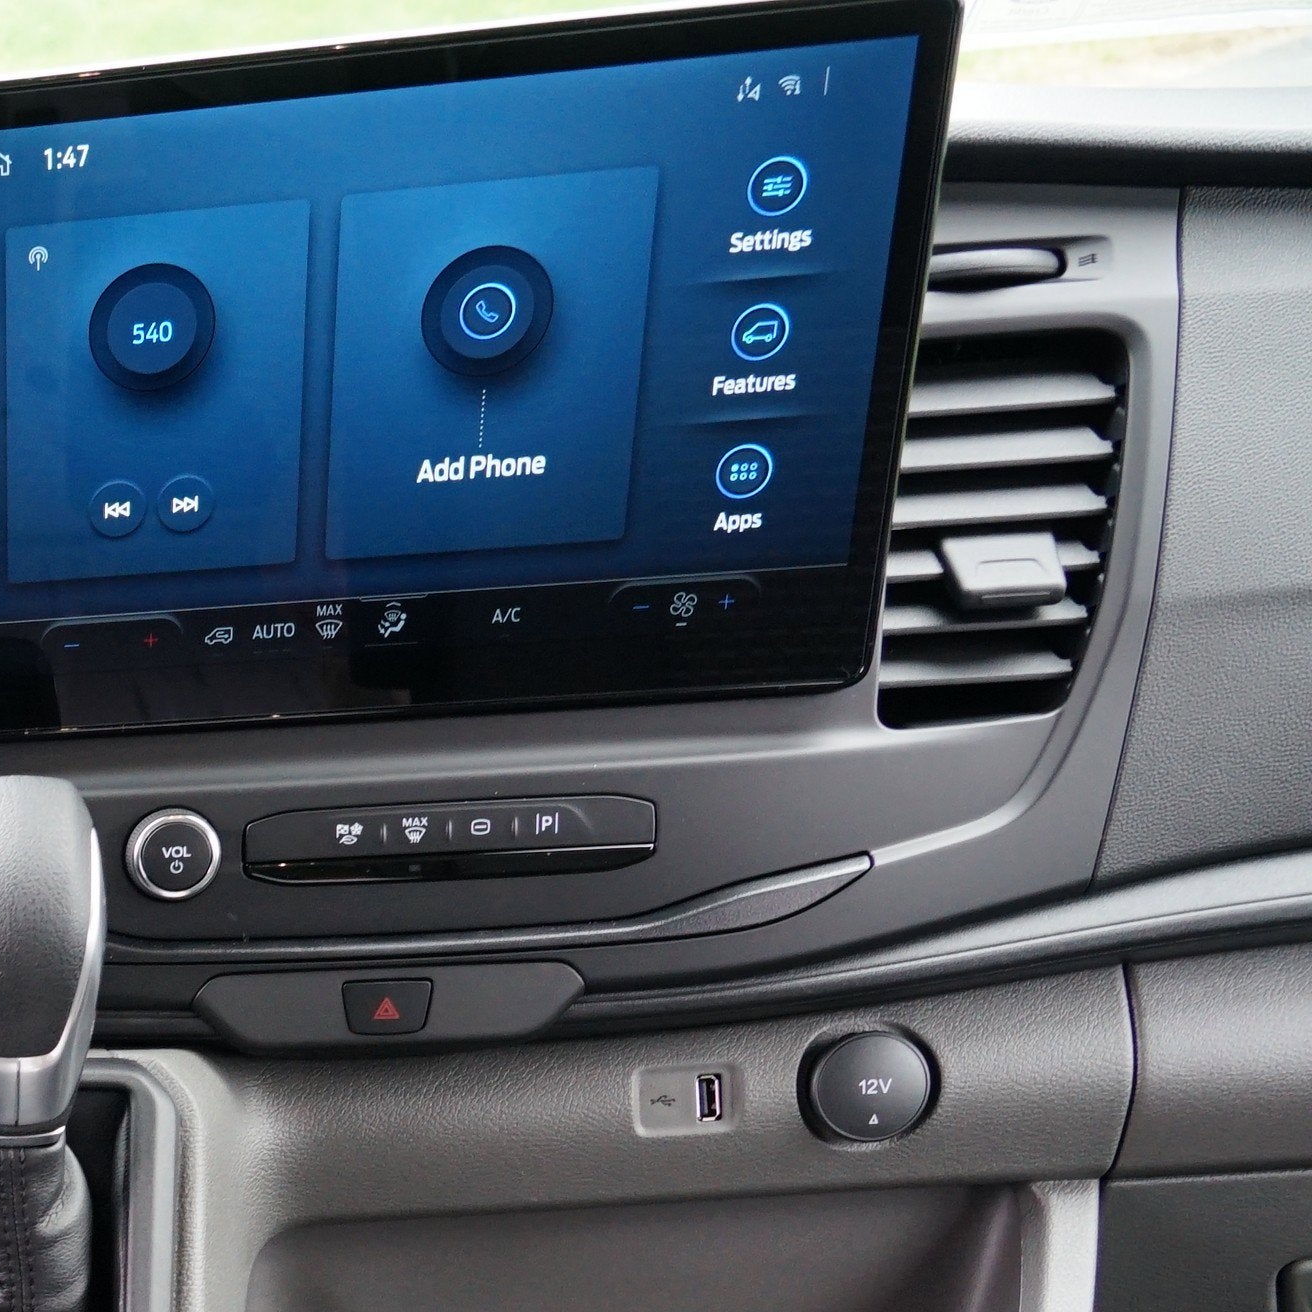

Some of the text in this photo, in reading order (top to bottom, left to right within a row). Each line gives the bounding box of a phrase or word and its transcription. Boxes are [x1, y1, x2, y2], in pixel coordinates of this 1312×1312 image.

[43, 144, 89, 170] 1:47
[729, 228, 813, 253] Settings
[132, 321, 173, 345] 540
[712, 373, 796, 397] Features
[416, 453, 547, 483] Add Phone
[713, 511, 763, 534] Apps
[316, 603, 343, 617] MAX
[491, 607, 521, 624] A/C
[252, 622, 296, 640] AUTO
[402, 816, 429, 828] MAX
[161, 845, 191, 859] VOL
[858, 1078, 892, 1095] 12V
